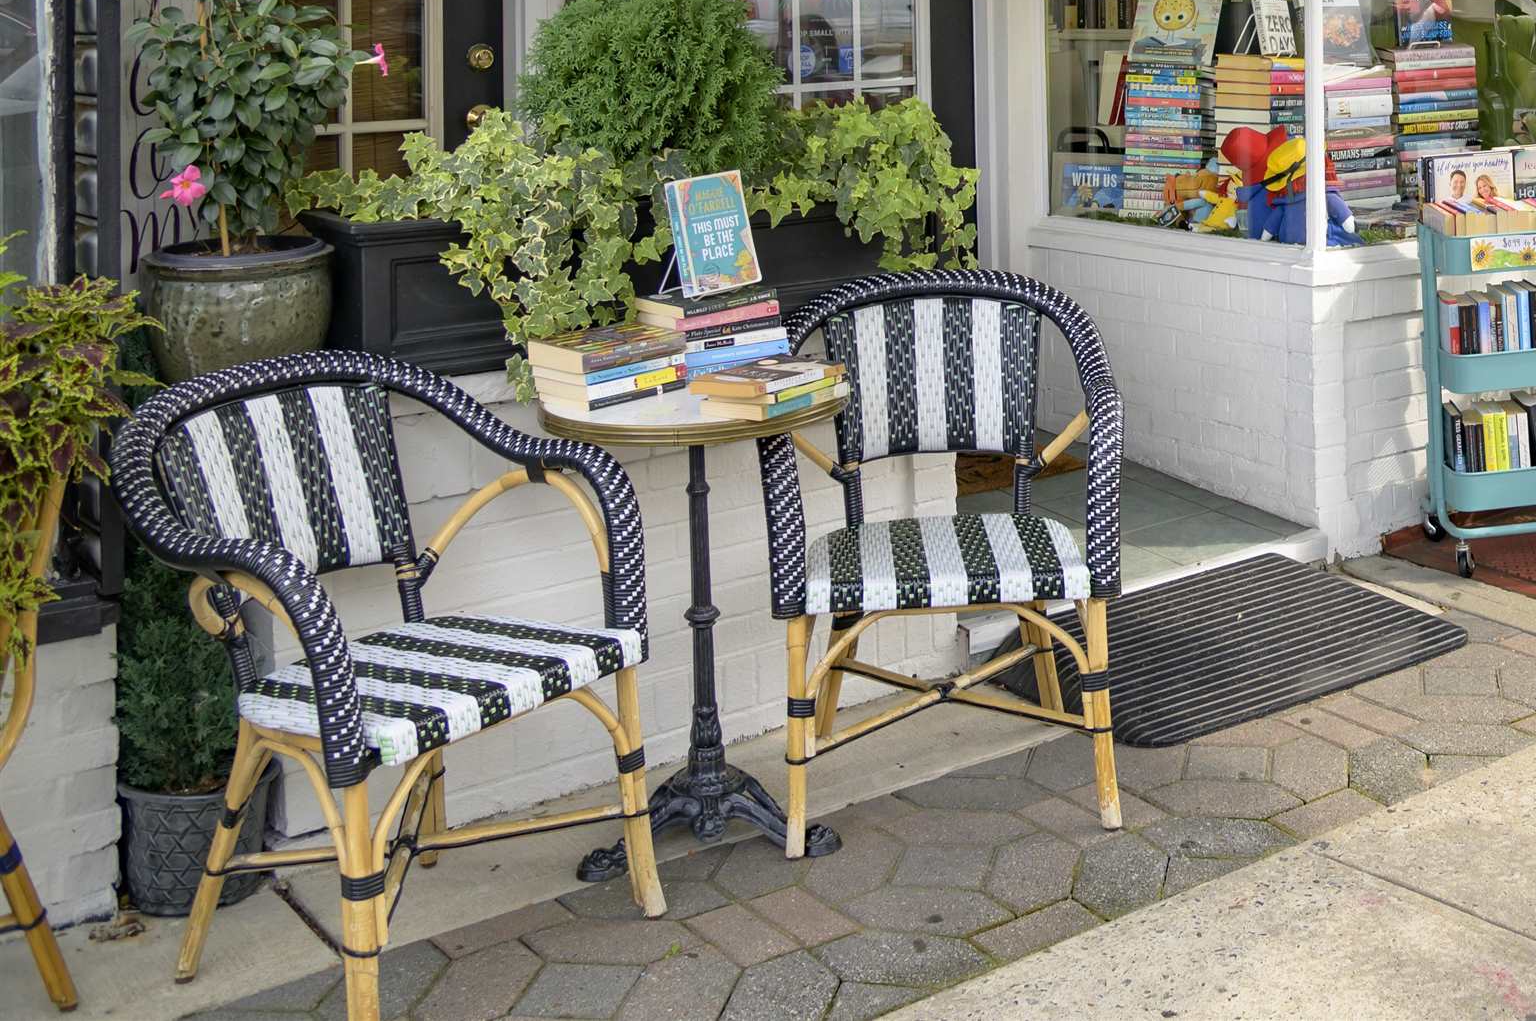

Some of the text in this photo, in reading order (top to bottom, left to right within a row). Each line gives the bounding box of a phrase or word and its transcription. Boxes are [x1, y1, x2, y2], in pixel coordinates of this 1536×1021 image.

[1072, 172, 1118, 188] WITH US
[691, 214, 740, 235] THIS MUST
[703, 230, 735, 247] BE THE
[702, 243, 735, 261] PLACE
